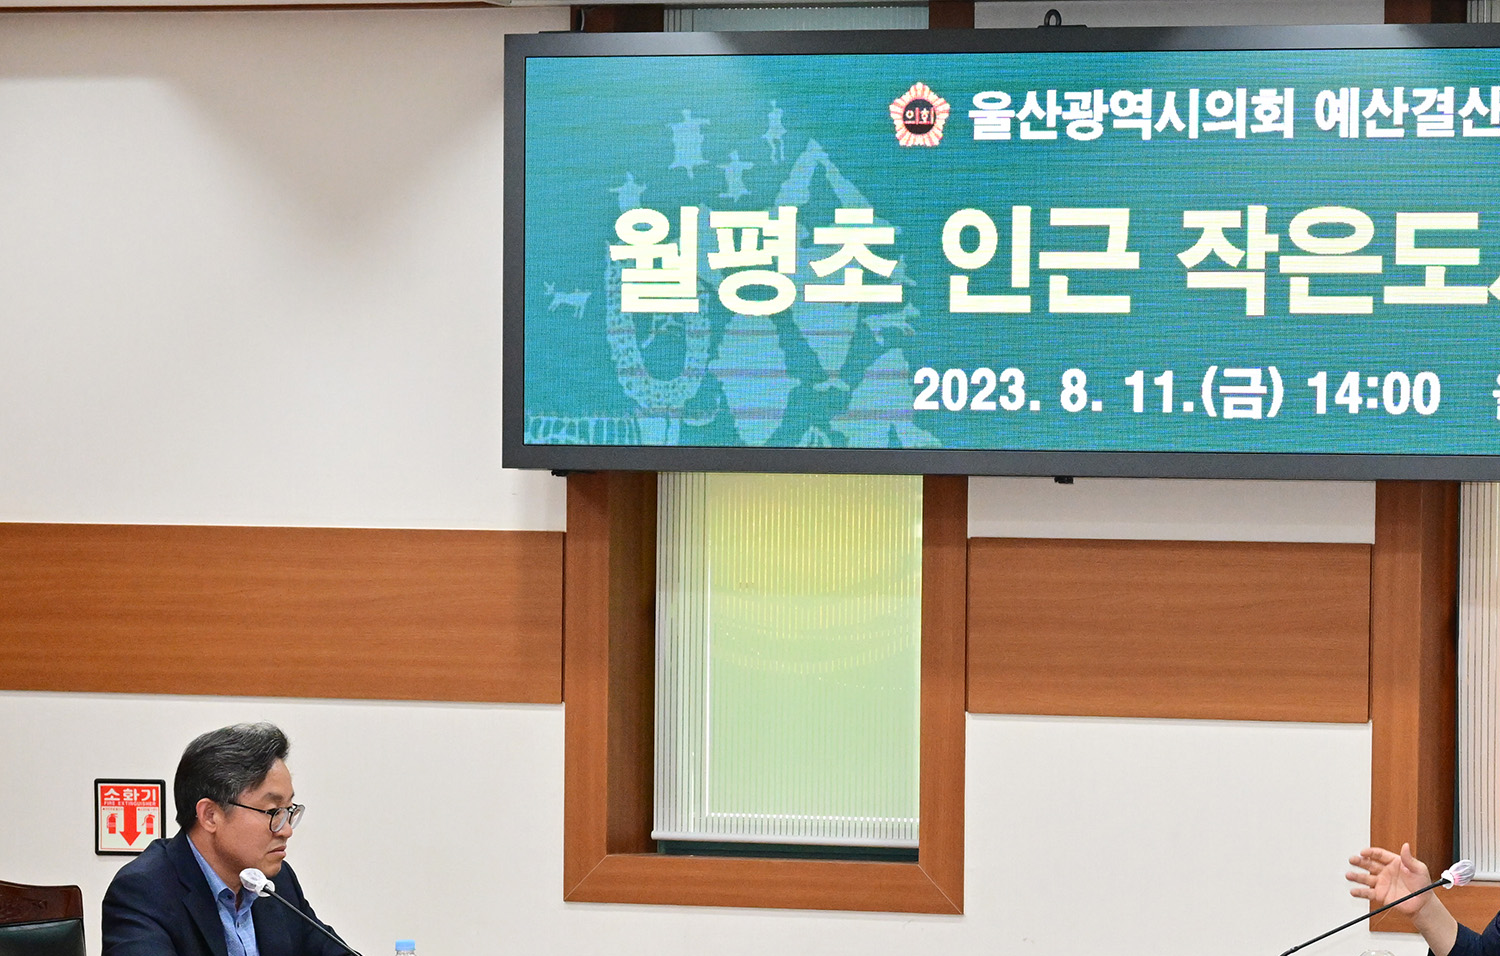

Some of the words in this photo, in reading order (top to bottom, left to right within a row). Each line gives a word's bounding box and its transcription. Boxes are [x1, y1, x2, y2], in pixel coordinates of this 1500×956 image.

[904, 107, 935, 125] 의회
[968, 87, 1297, 143] 울산광역시의회
[609, 206, 905, 318] 월평초
[942, 205, 1142, 316] 인근
[913, 367, 1043, 414] 2023.
[1060, 368, 1105, 415] 8.
[1124, 365, 1286, 422] 11.(금)
[1307, 371, 1443, 418] 14:00
[104, 788, 157, 802] 소화기
